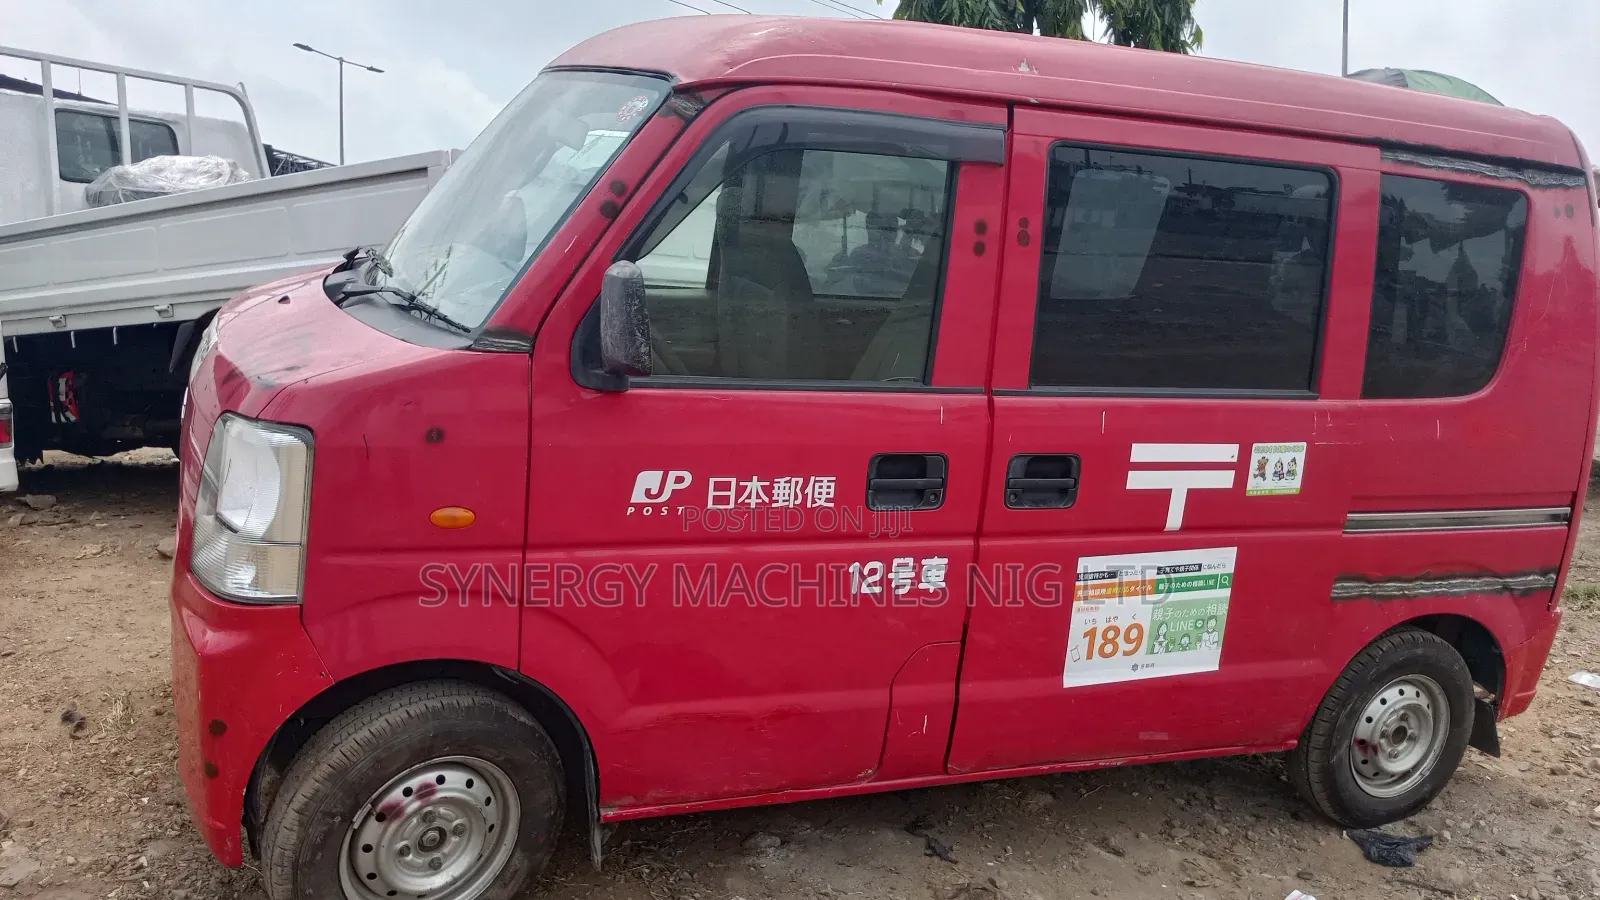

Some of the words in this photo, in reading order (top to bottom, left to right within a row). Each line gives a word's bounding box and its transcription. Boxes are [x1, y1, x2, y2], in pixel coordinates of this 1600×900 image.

[630, 470, 693, 503] JP
[707, 475, 837, 509] 日本郵便
[626, 506, 685, 516] POST
[849, 556, 949, 595] 12号車
[1152, 602, 1228, 621] 親子のための相談
[1170, 620, 1194, 631] LINE
[1083, 623, 1144, 660] 189
